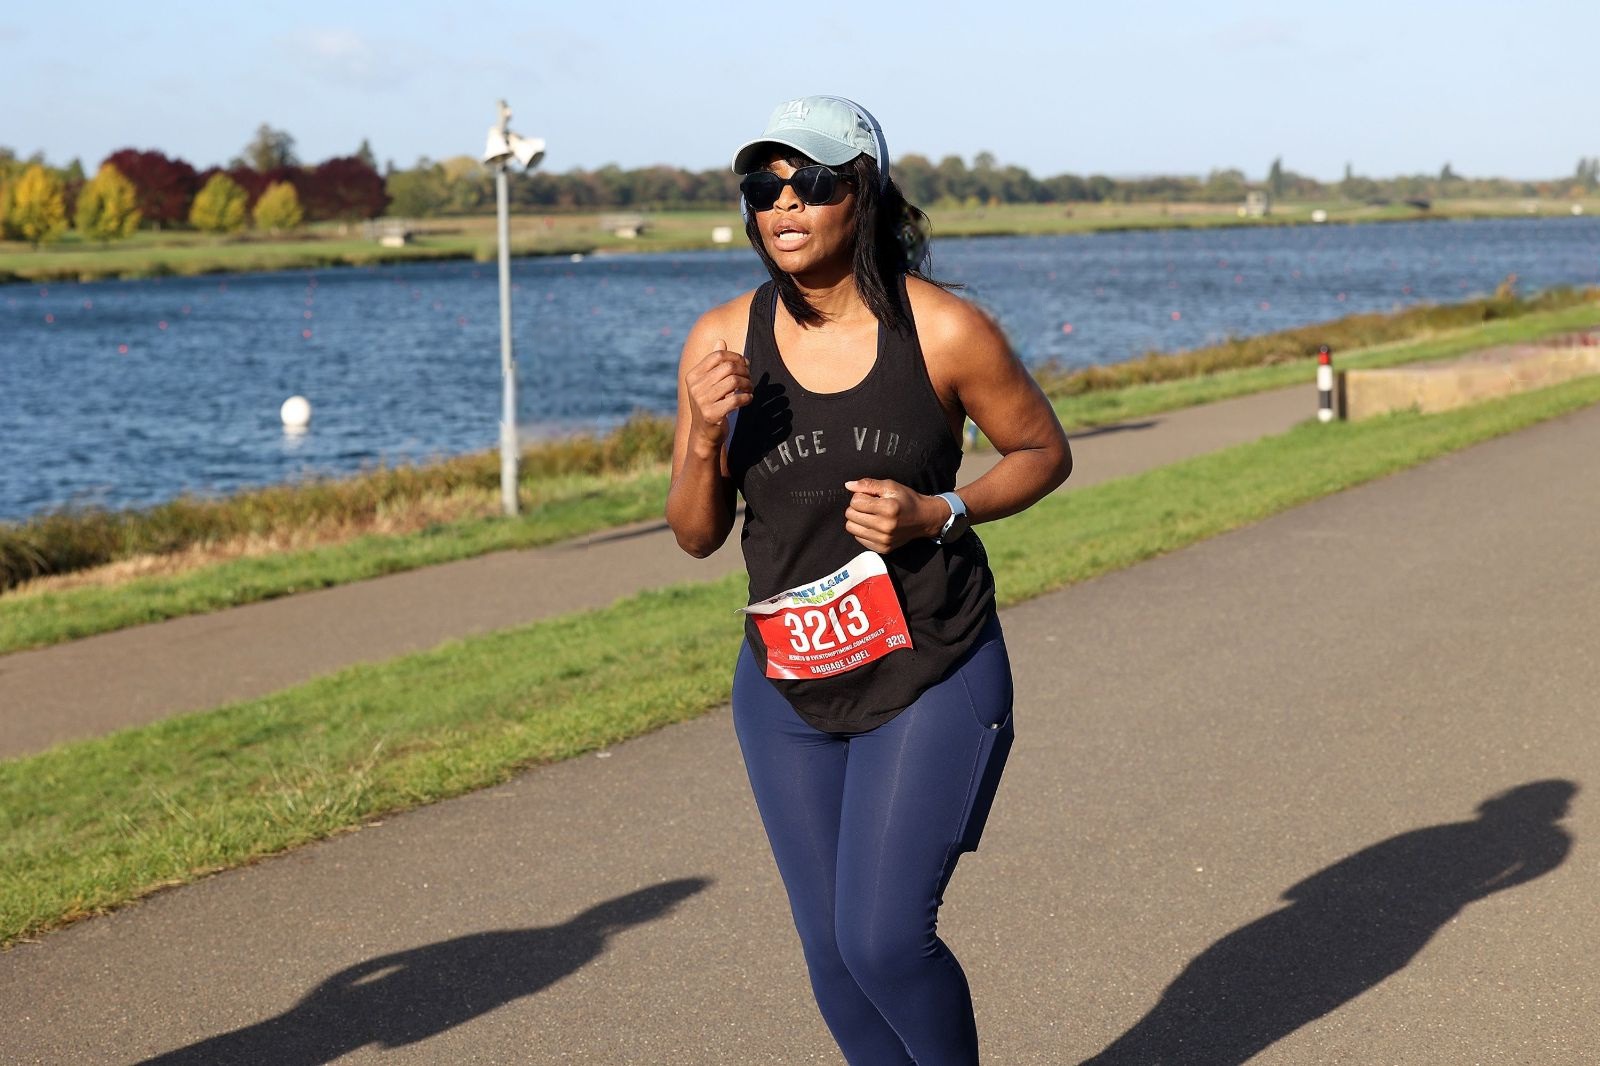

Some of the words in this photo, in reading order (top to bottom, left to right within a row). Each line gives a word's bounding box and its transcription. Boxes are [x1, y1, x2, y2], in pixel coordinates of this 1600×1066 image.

[820, 569, 850, 592] LAKE
[784, 594, 870, 653] 3213
[885, 633, 907, 648] 3213
[810, 659, 846, 674] BAGGAGE
[847, 649, 871, 665] LABEL
